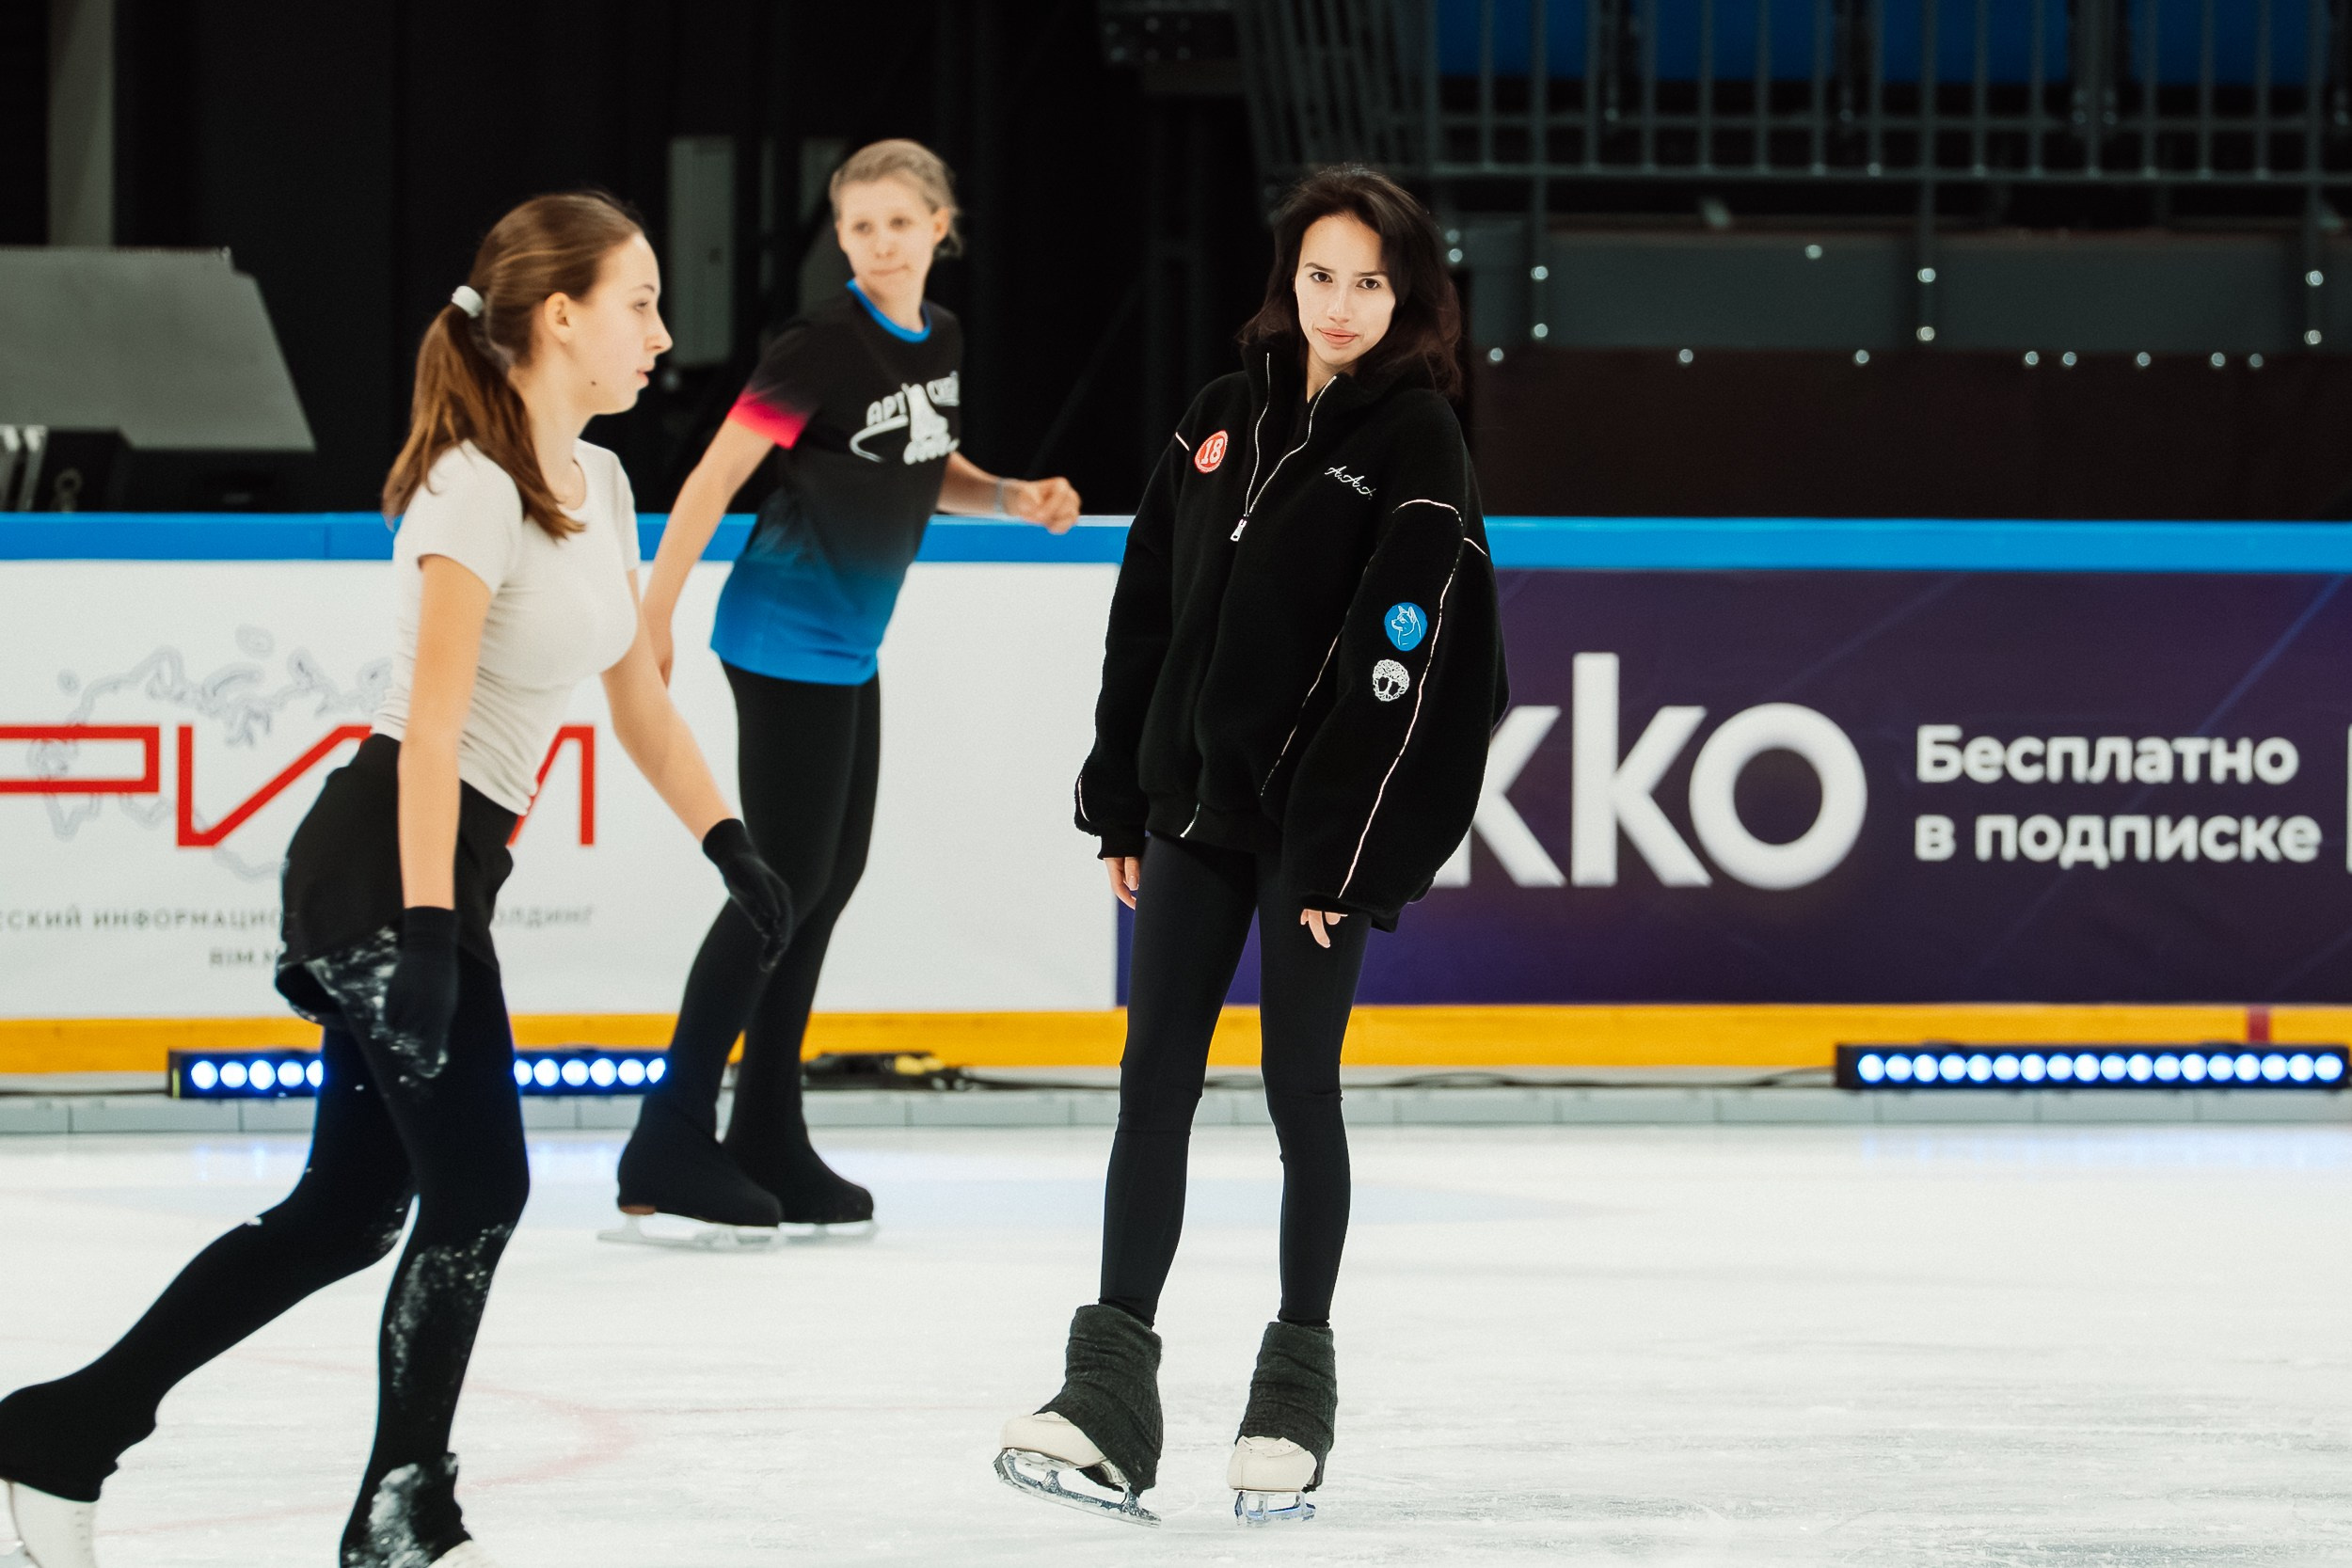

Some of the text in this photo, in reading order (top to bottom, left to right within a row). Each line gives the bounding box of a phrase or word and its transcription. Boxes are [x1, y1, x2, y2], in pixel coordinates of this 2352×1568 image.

[1200, 437, 1224, 464] 18
[1916, 724, 2298, 784] Бесплатно
[1915, 815, 2322, 868] в подписке
[0, 904, 82, 931] СКИЙ
